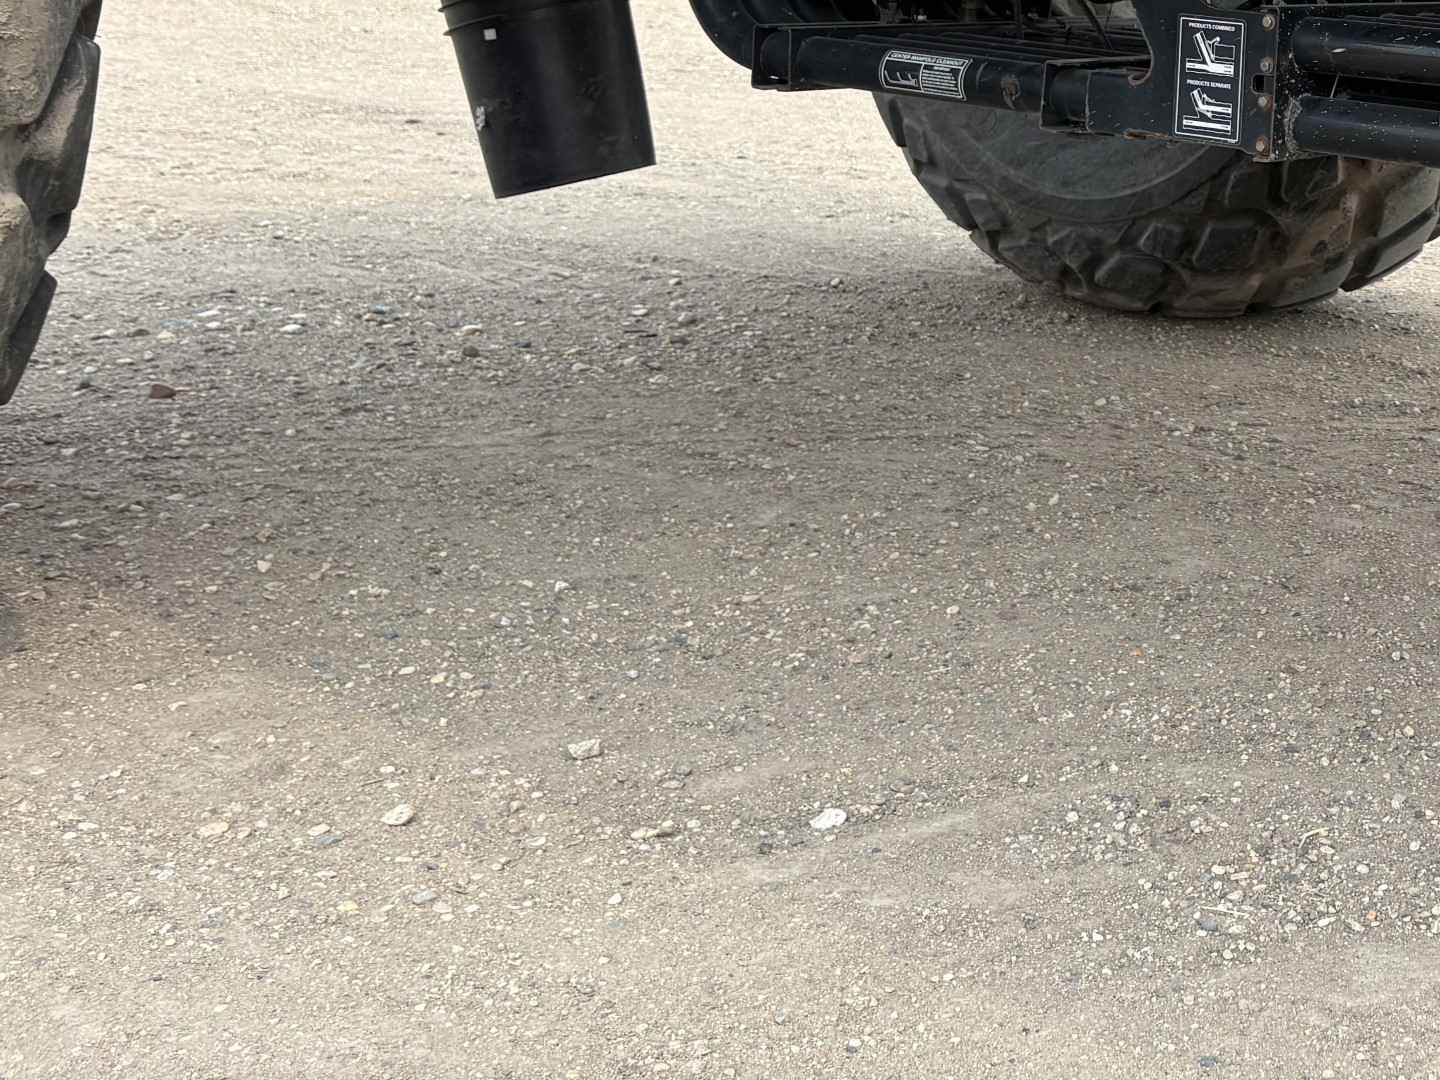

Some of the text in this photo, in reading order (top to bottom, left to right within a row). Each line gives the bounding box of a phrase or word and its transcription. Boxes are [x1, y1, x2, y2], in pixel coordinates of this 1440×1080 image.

[1188, 22, 1236, 32] PRODUCTS COMBINED
[1186, 79, 1210, 87] PRODUCTS
